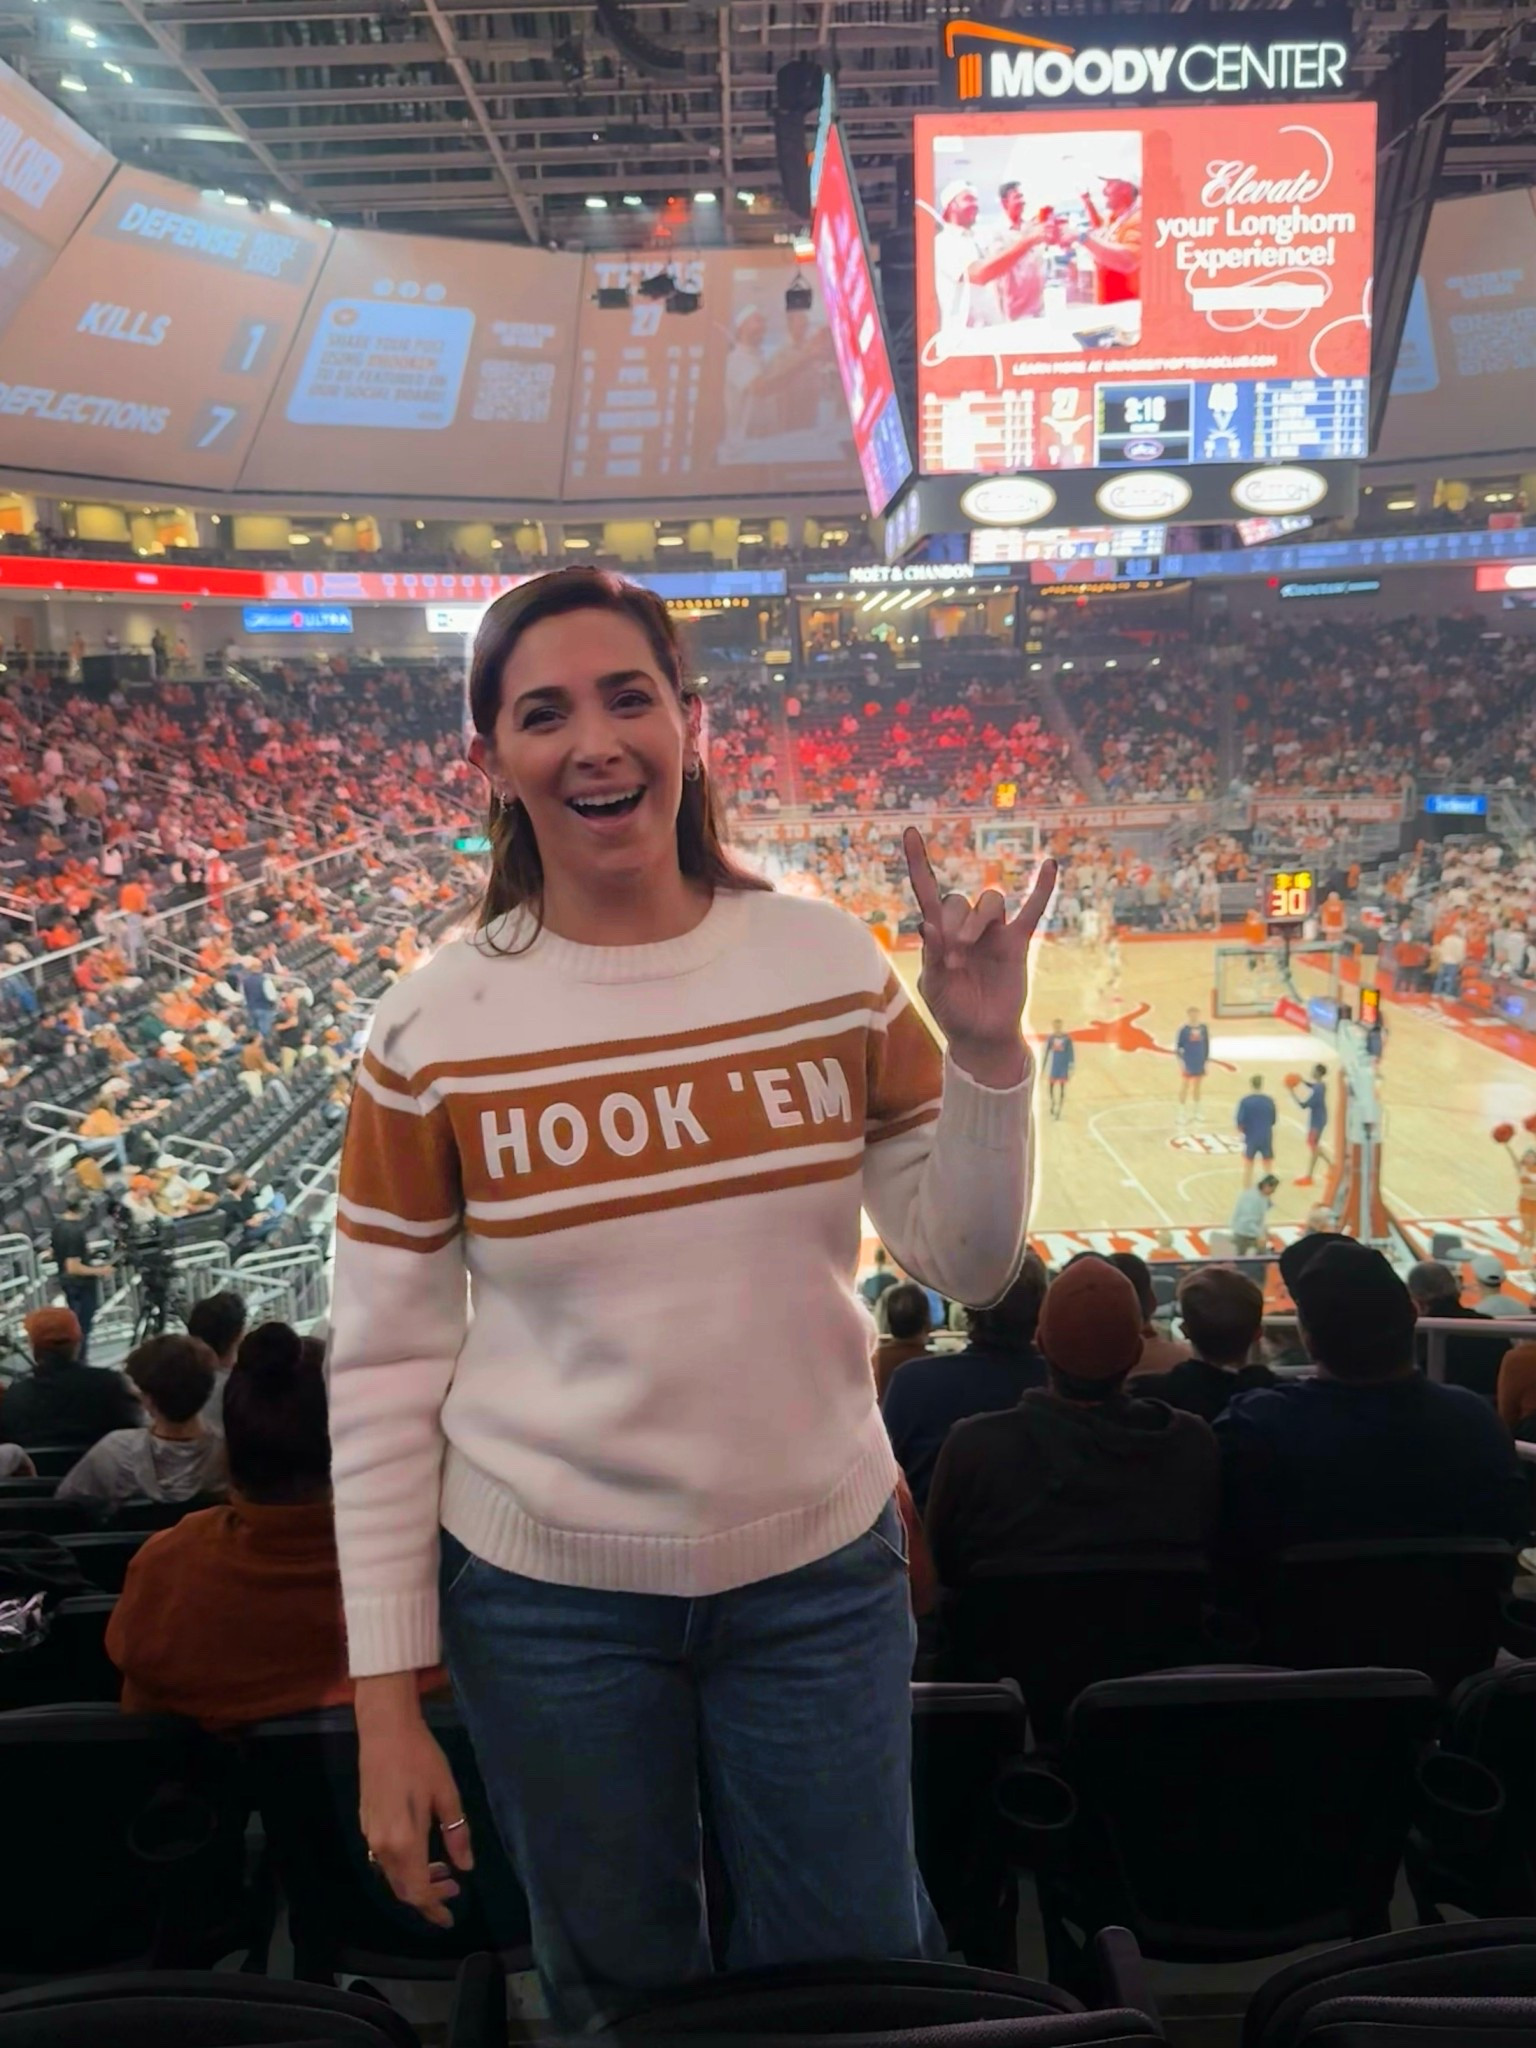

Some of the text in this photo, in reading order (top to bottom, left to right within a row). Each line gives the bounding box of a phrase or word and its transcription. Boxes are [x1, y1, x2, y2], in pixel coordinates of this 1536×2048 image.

[990, 41, 1347, 98] MOODY CENTER
[1200, 158, 1327, 208] Elevate
[117, 201, 246, 260] DEFENSE
[1155, 206, 1356, 249] your Longhorn
[1176, 237, 1336, 278] Experience!
[76, 301, 172, 347] KILLS
[240, 323, 267, 372] 1
[197, 405, 237, 448] 7
[904, 562, 975, 582] CHANDON
[304, 611, 350, 627] ULTRA
[1272, 889, 1306, 916] 30
[479, 1057, 852, 1180] HOOK 'EM
